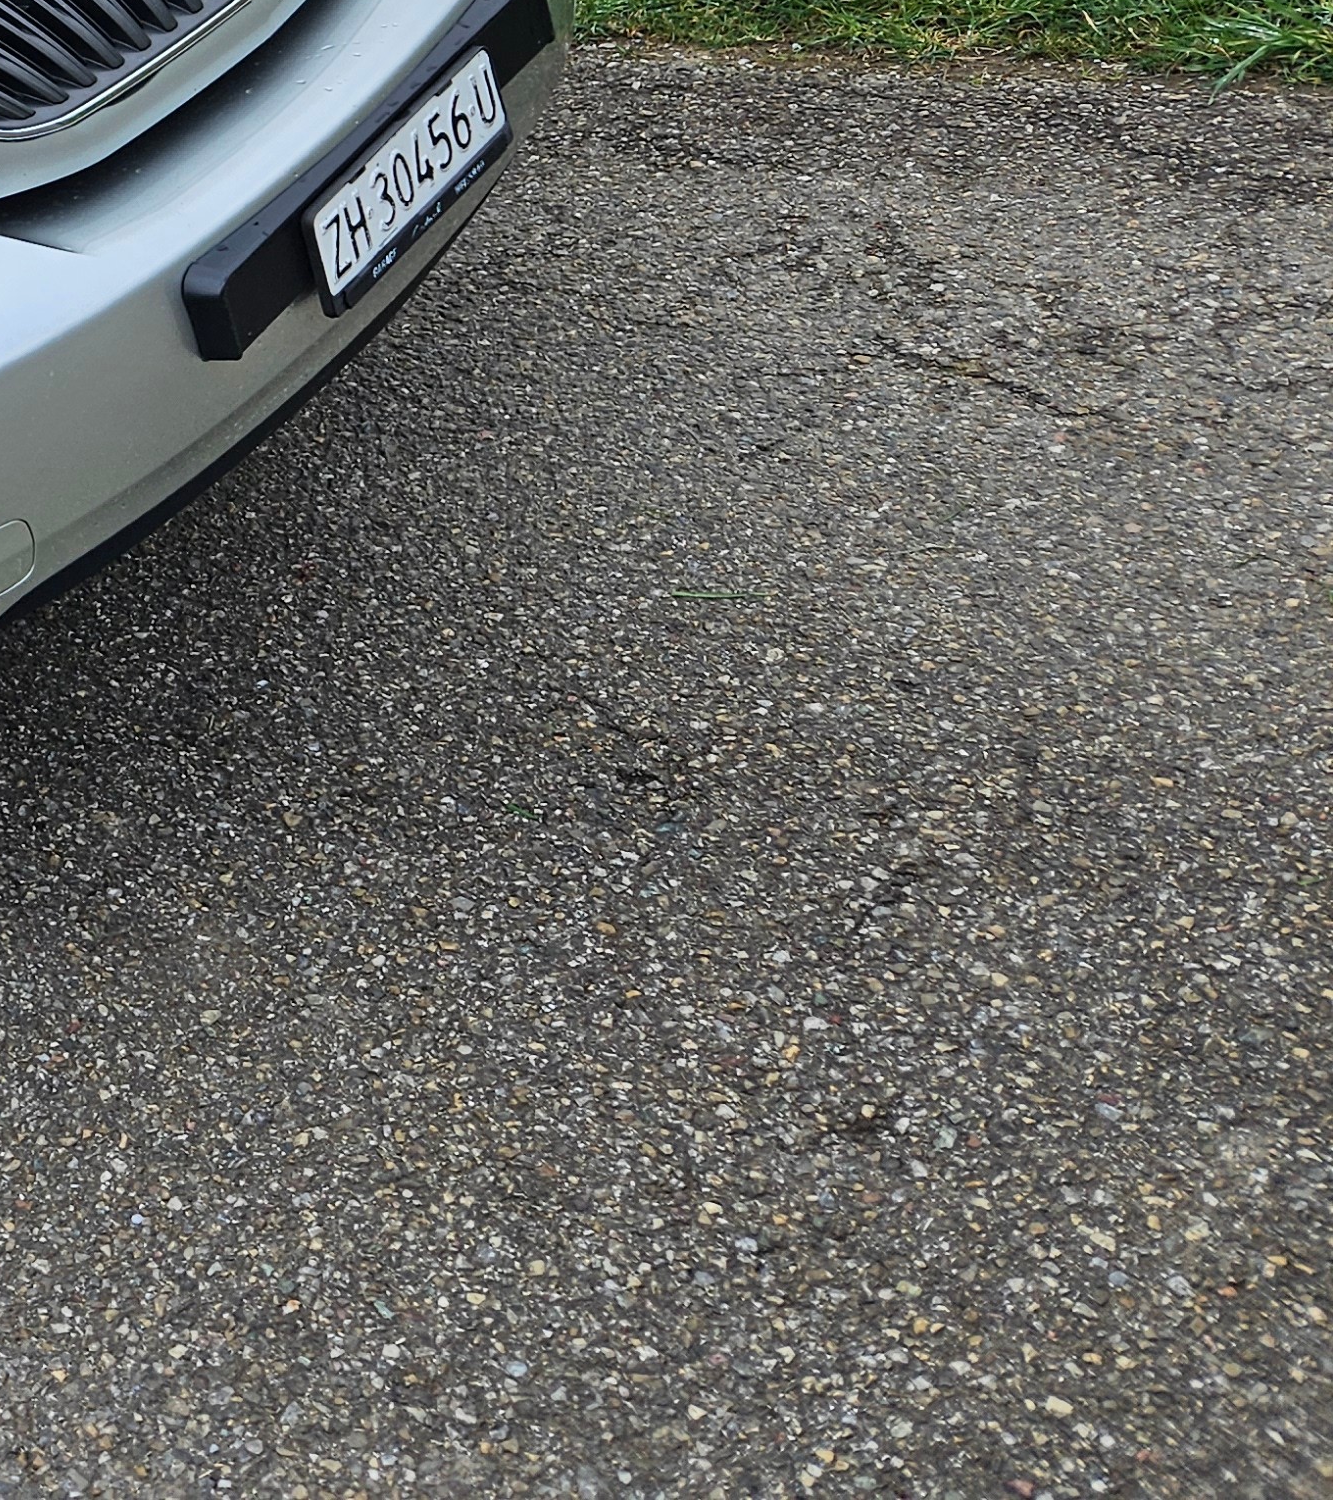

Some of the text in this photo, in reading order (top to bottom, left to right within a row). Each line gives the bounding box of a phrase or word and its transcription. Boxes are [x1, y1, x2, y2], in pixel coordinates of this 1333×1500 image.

[322, 190, 372, 282] ZH
[371, 91, 471, 229] 30456
[470, 64, 496, 126] U
